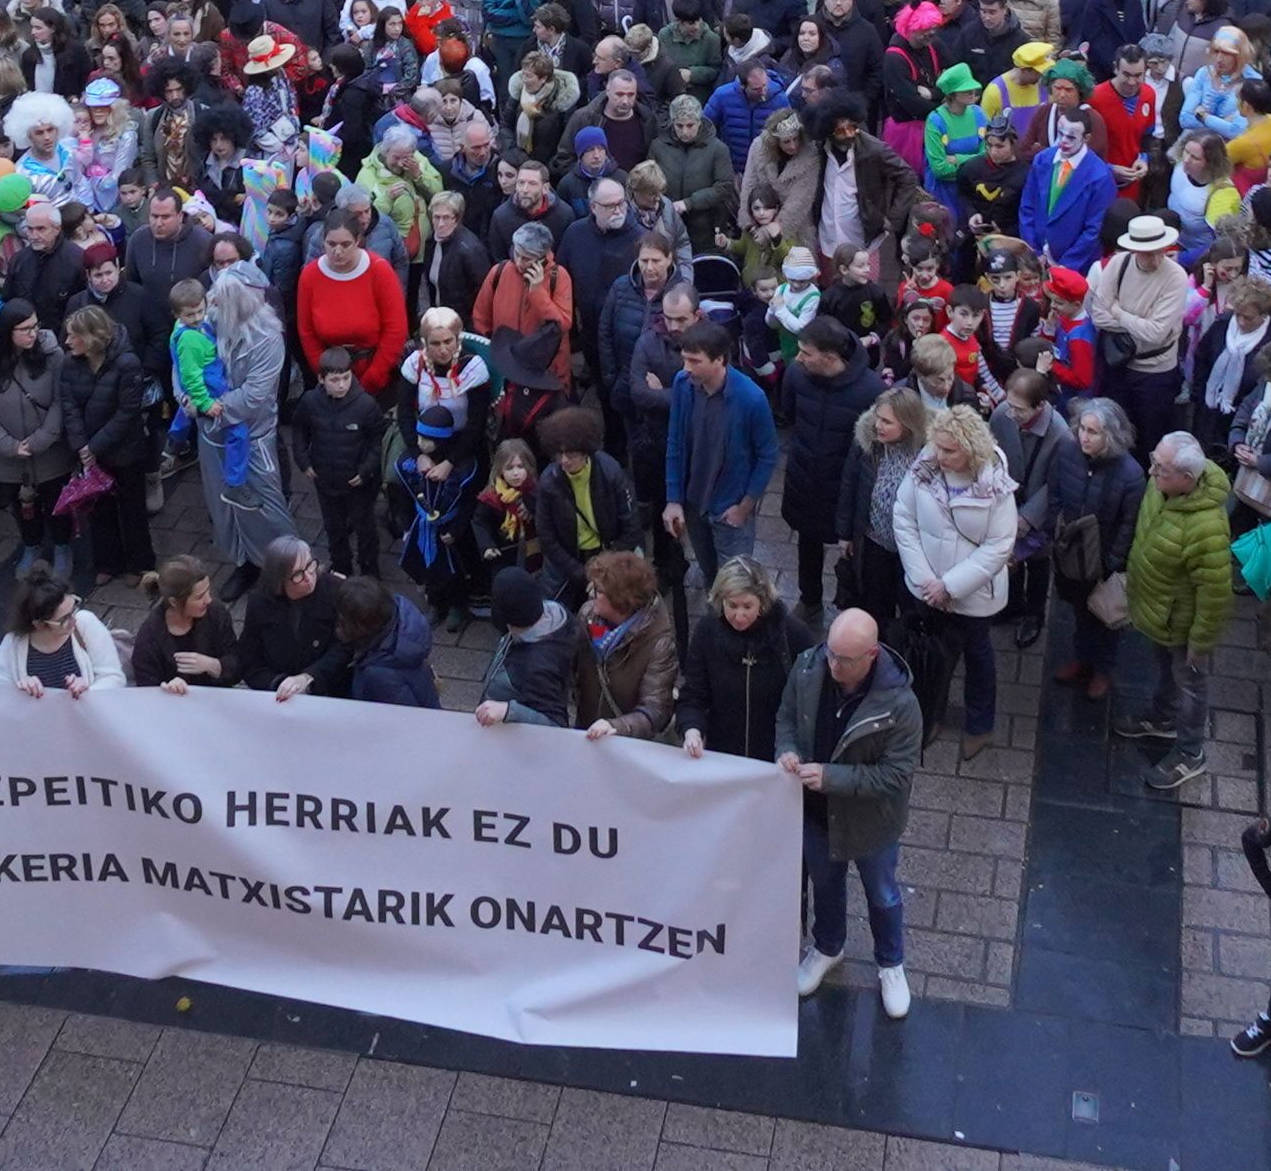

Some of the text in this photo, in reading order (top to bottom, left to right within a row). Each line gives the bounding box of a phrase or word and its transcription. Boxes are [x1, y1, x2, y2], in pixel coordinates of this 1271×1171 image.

[225, 790, 453, 840] HERRIAK
[472, 809, 532, 849] EZ
[552, 822, 619, 860] DU
[141, 857, 456, 928] MATXISTARIK
[469, 895, 726, 960] ONARTZEN
